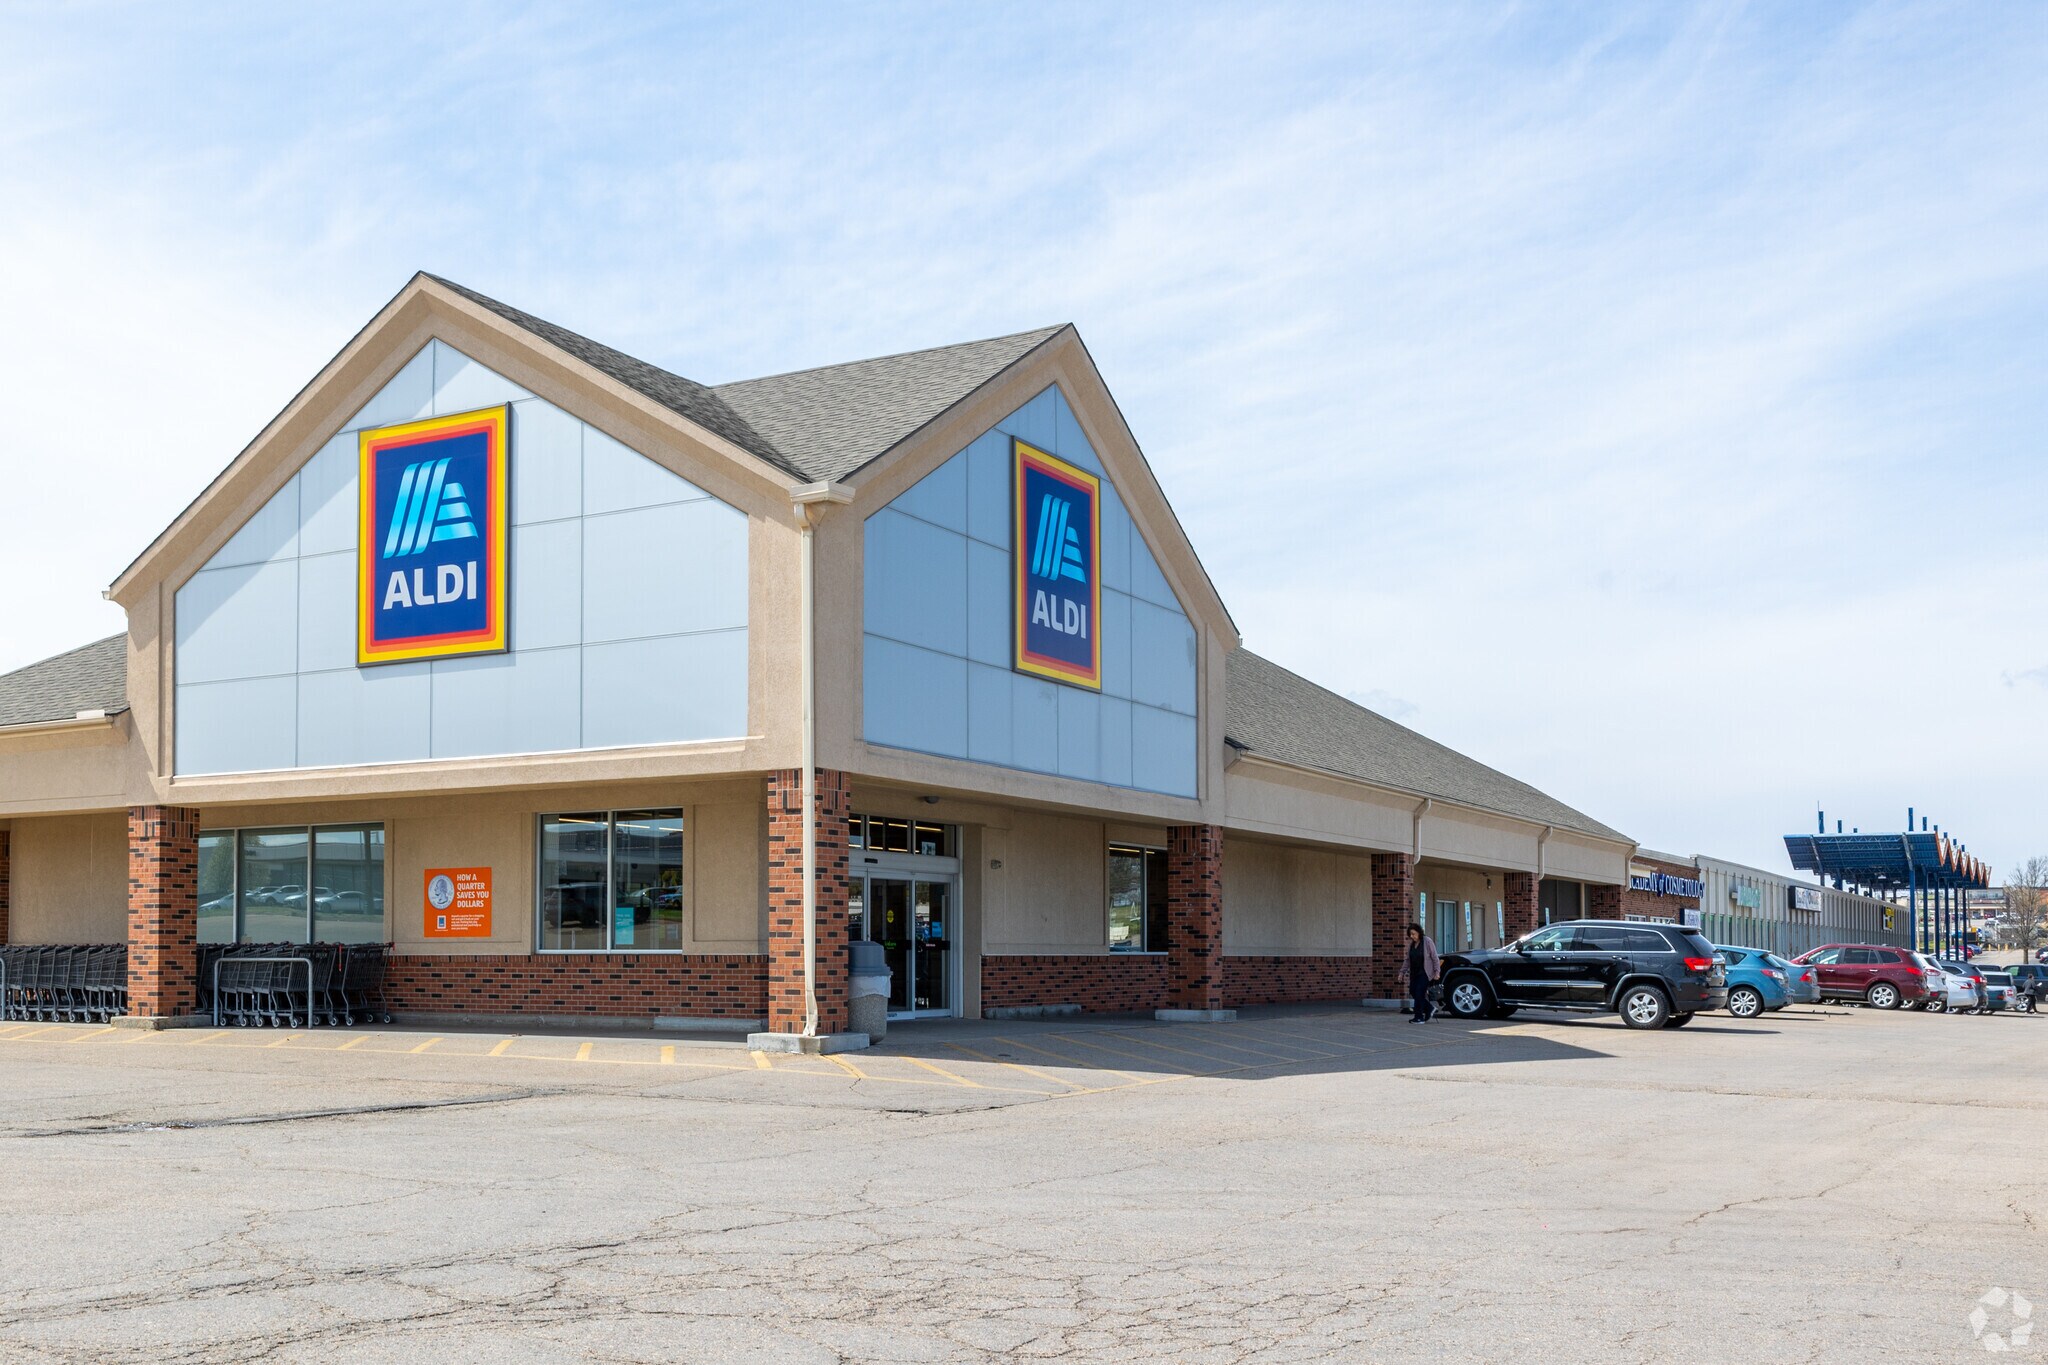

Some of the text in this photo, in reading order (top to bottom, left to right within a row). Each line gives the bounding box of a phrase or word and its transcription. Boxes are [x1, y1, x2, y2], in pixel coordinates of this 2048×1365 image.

[382, 561, 478, 610] ALDI
[1032, 589, 1087, 639] ALDI
[472, 873, 477, 881] A
[457, 882, 485, 891] QUARTER
[1631, 872, 1658, 893] CADEMY
[1665, 875, 1705, 899] COSMETOLOGY
[456, 891, 489, 899] SAVES YOU
[457, 900, 484, 908] DOLLARS
